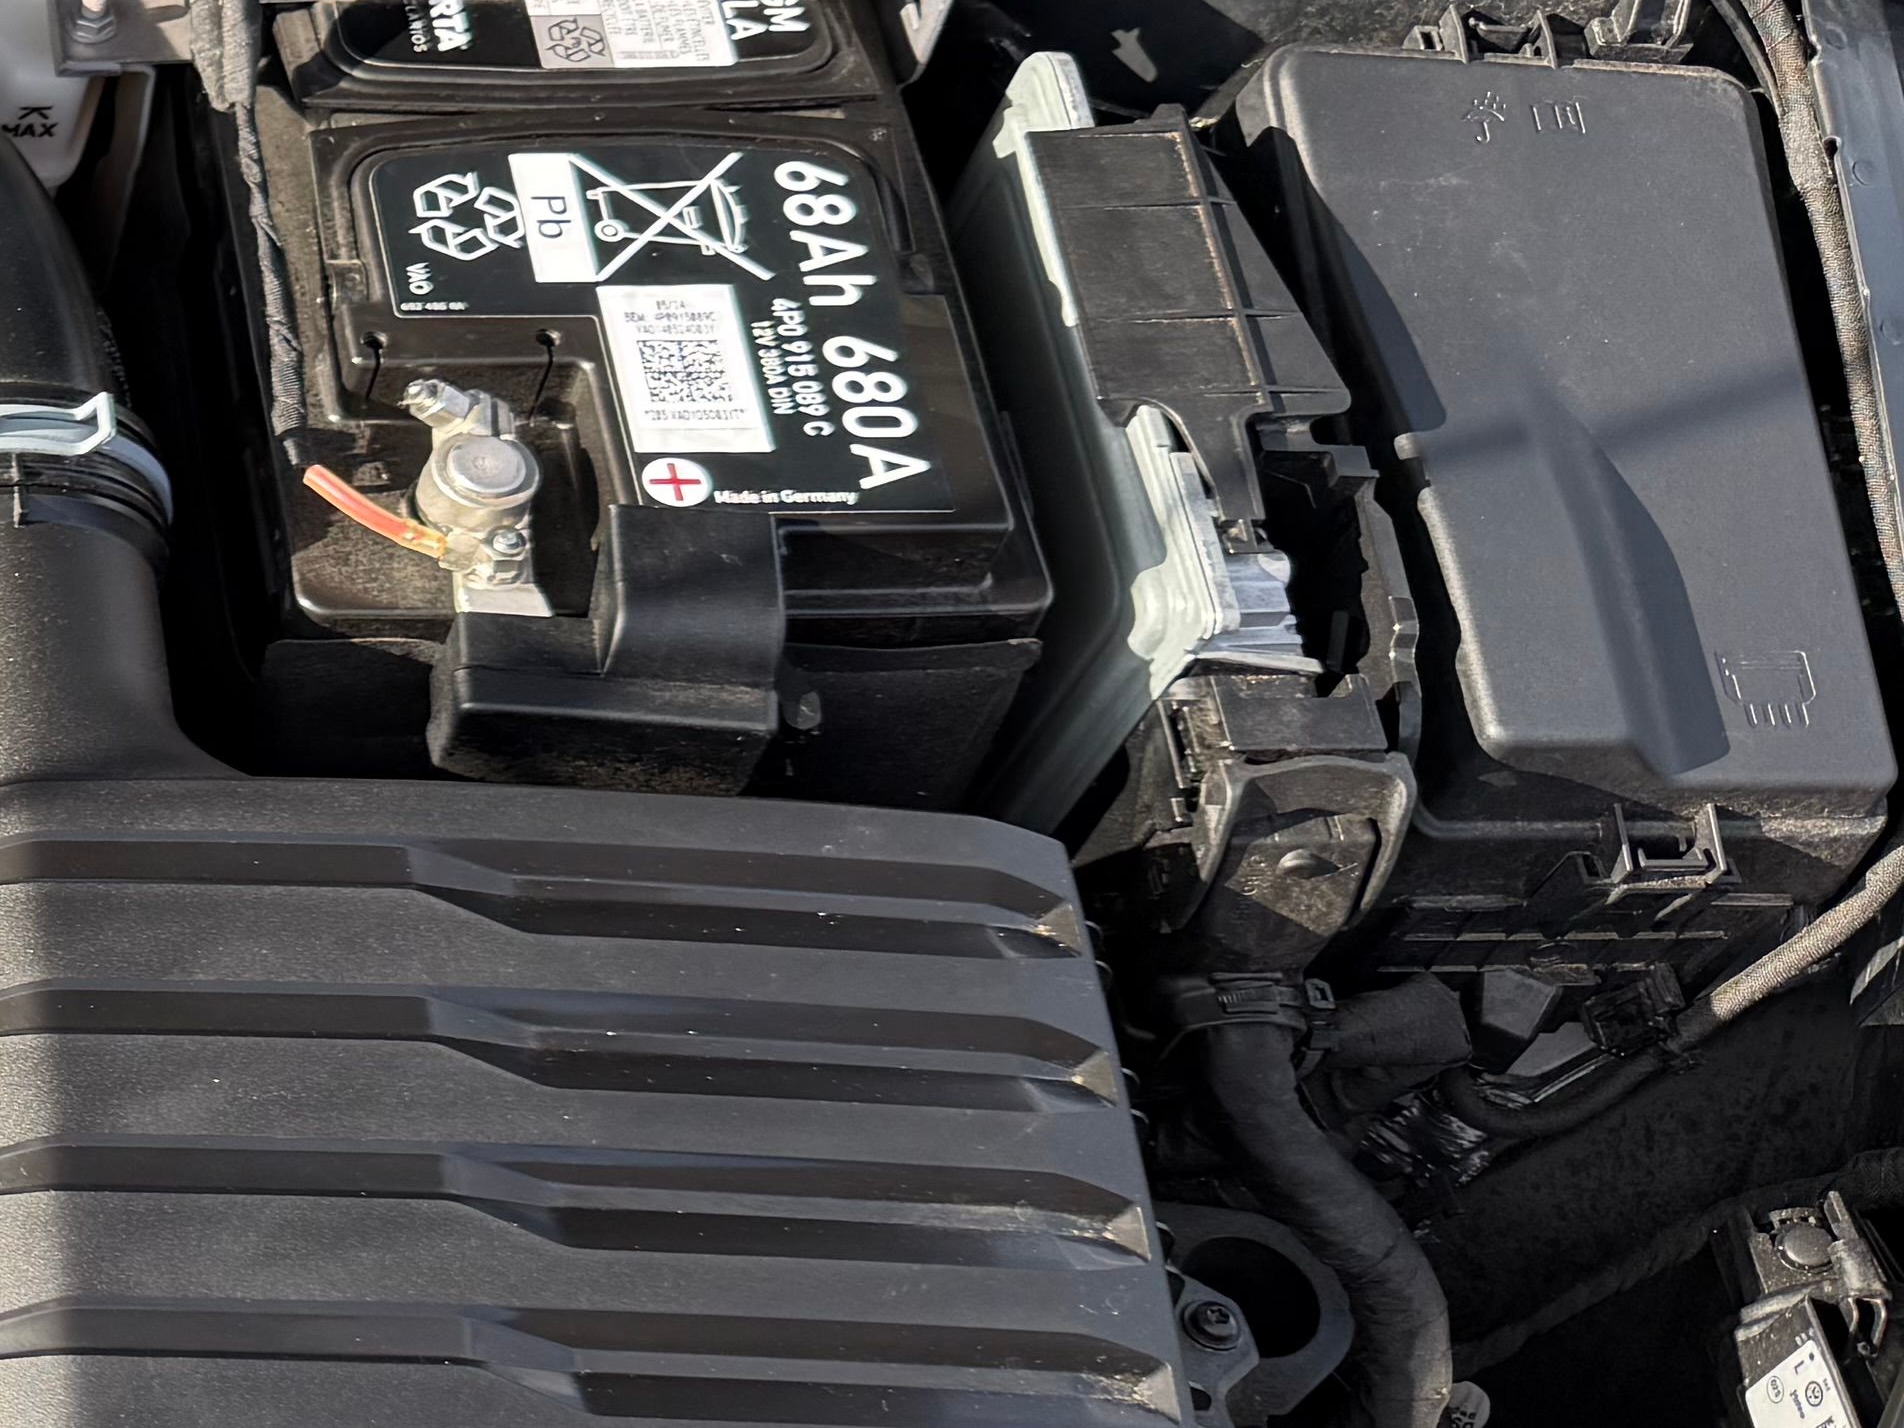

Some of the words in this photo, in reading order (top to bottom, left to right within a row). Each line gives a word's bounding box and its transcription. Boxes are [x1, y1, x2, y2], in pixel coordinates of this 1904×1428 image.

[530, 195, 572, 239] Pb
[773, 160, 878, 307] 68Ah
[750, 320, 781, 347] 12V
[770, 298, 809, 337] 4P0
[757, 348, 789, 384] 380A
[781, 340, 820, 377] 915
[767, 387, 800, 415] DIN
[792, 380, 831, 416] 089
[822, 335, 932, 489] 680A
[803, 421, 835, 437] C
[713, 490, 760, 504] Made
[760, 490, 779, 504] in
[779, 489, 860, 505] Germany
